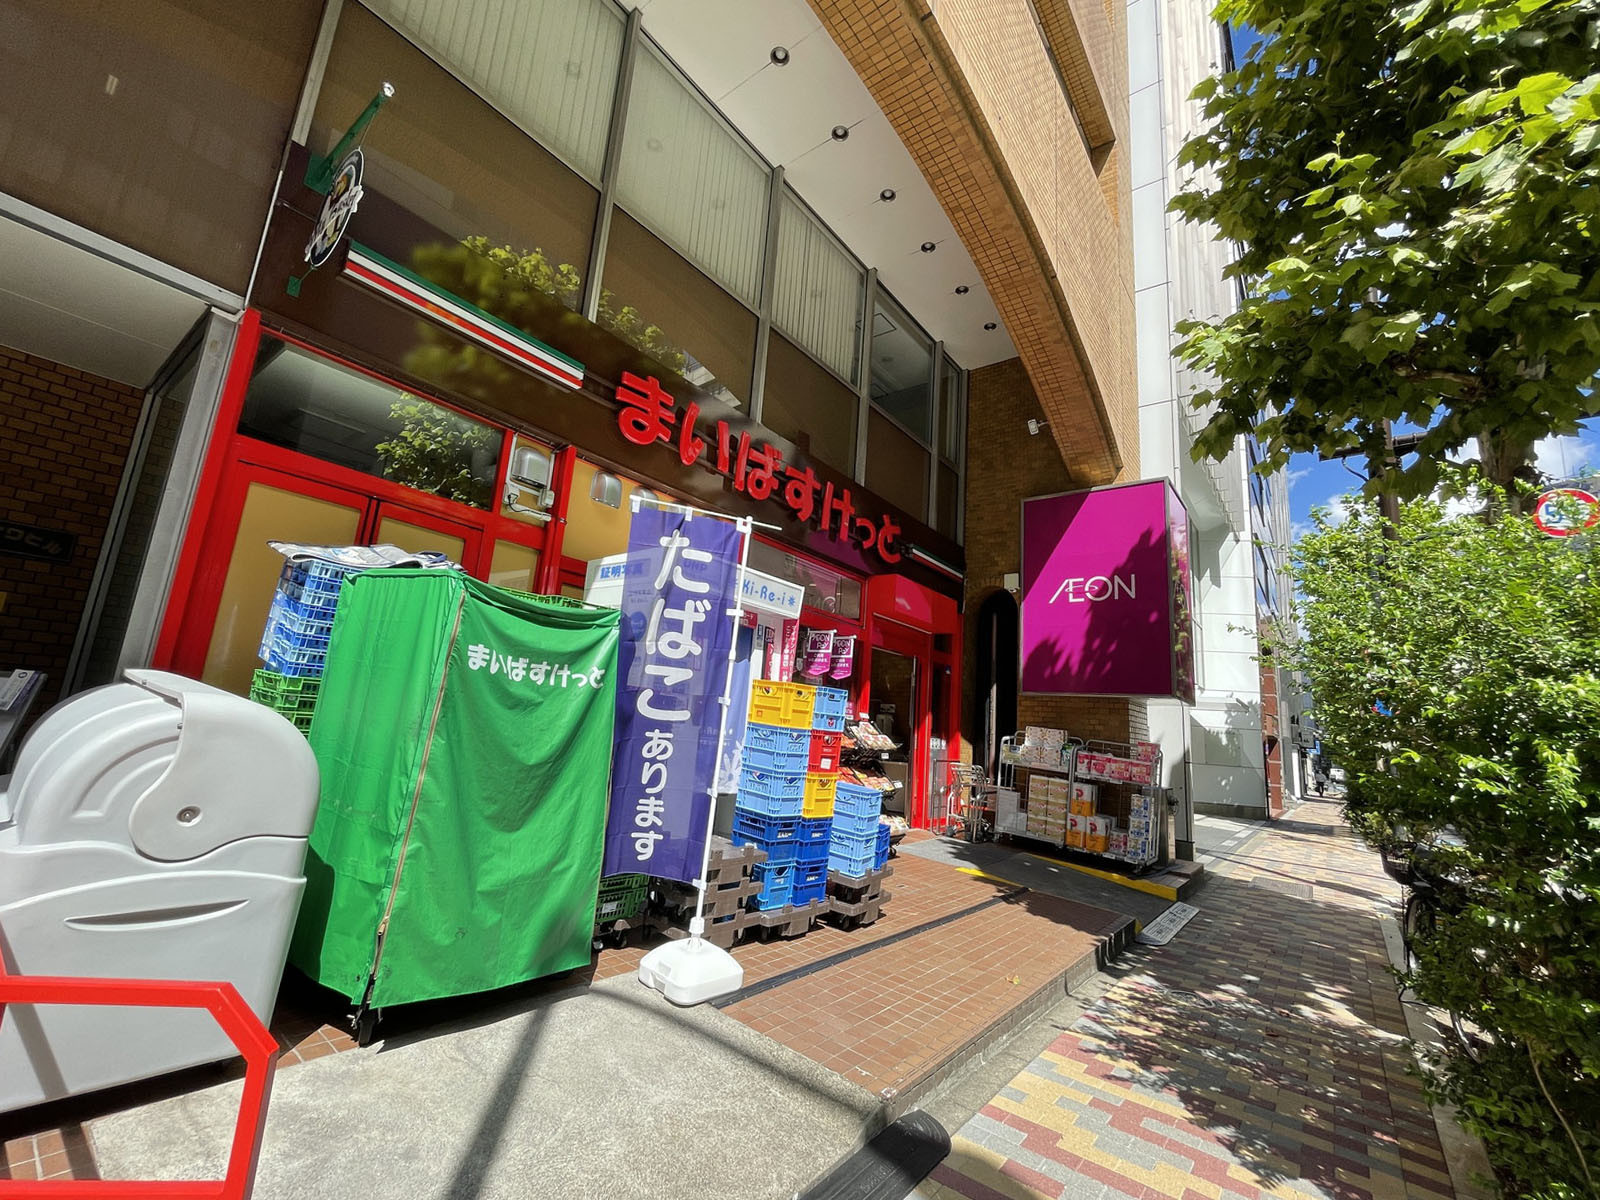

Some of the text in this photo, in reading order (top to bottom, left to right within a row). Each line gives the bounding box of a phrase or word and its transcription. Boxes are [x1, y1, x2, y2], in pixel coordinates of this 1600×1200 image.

[615, 371, 901, 564] まいばすけっと
[467, 643, 605, 689] まいばすけっと
